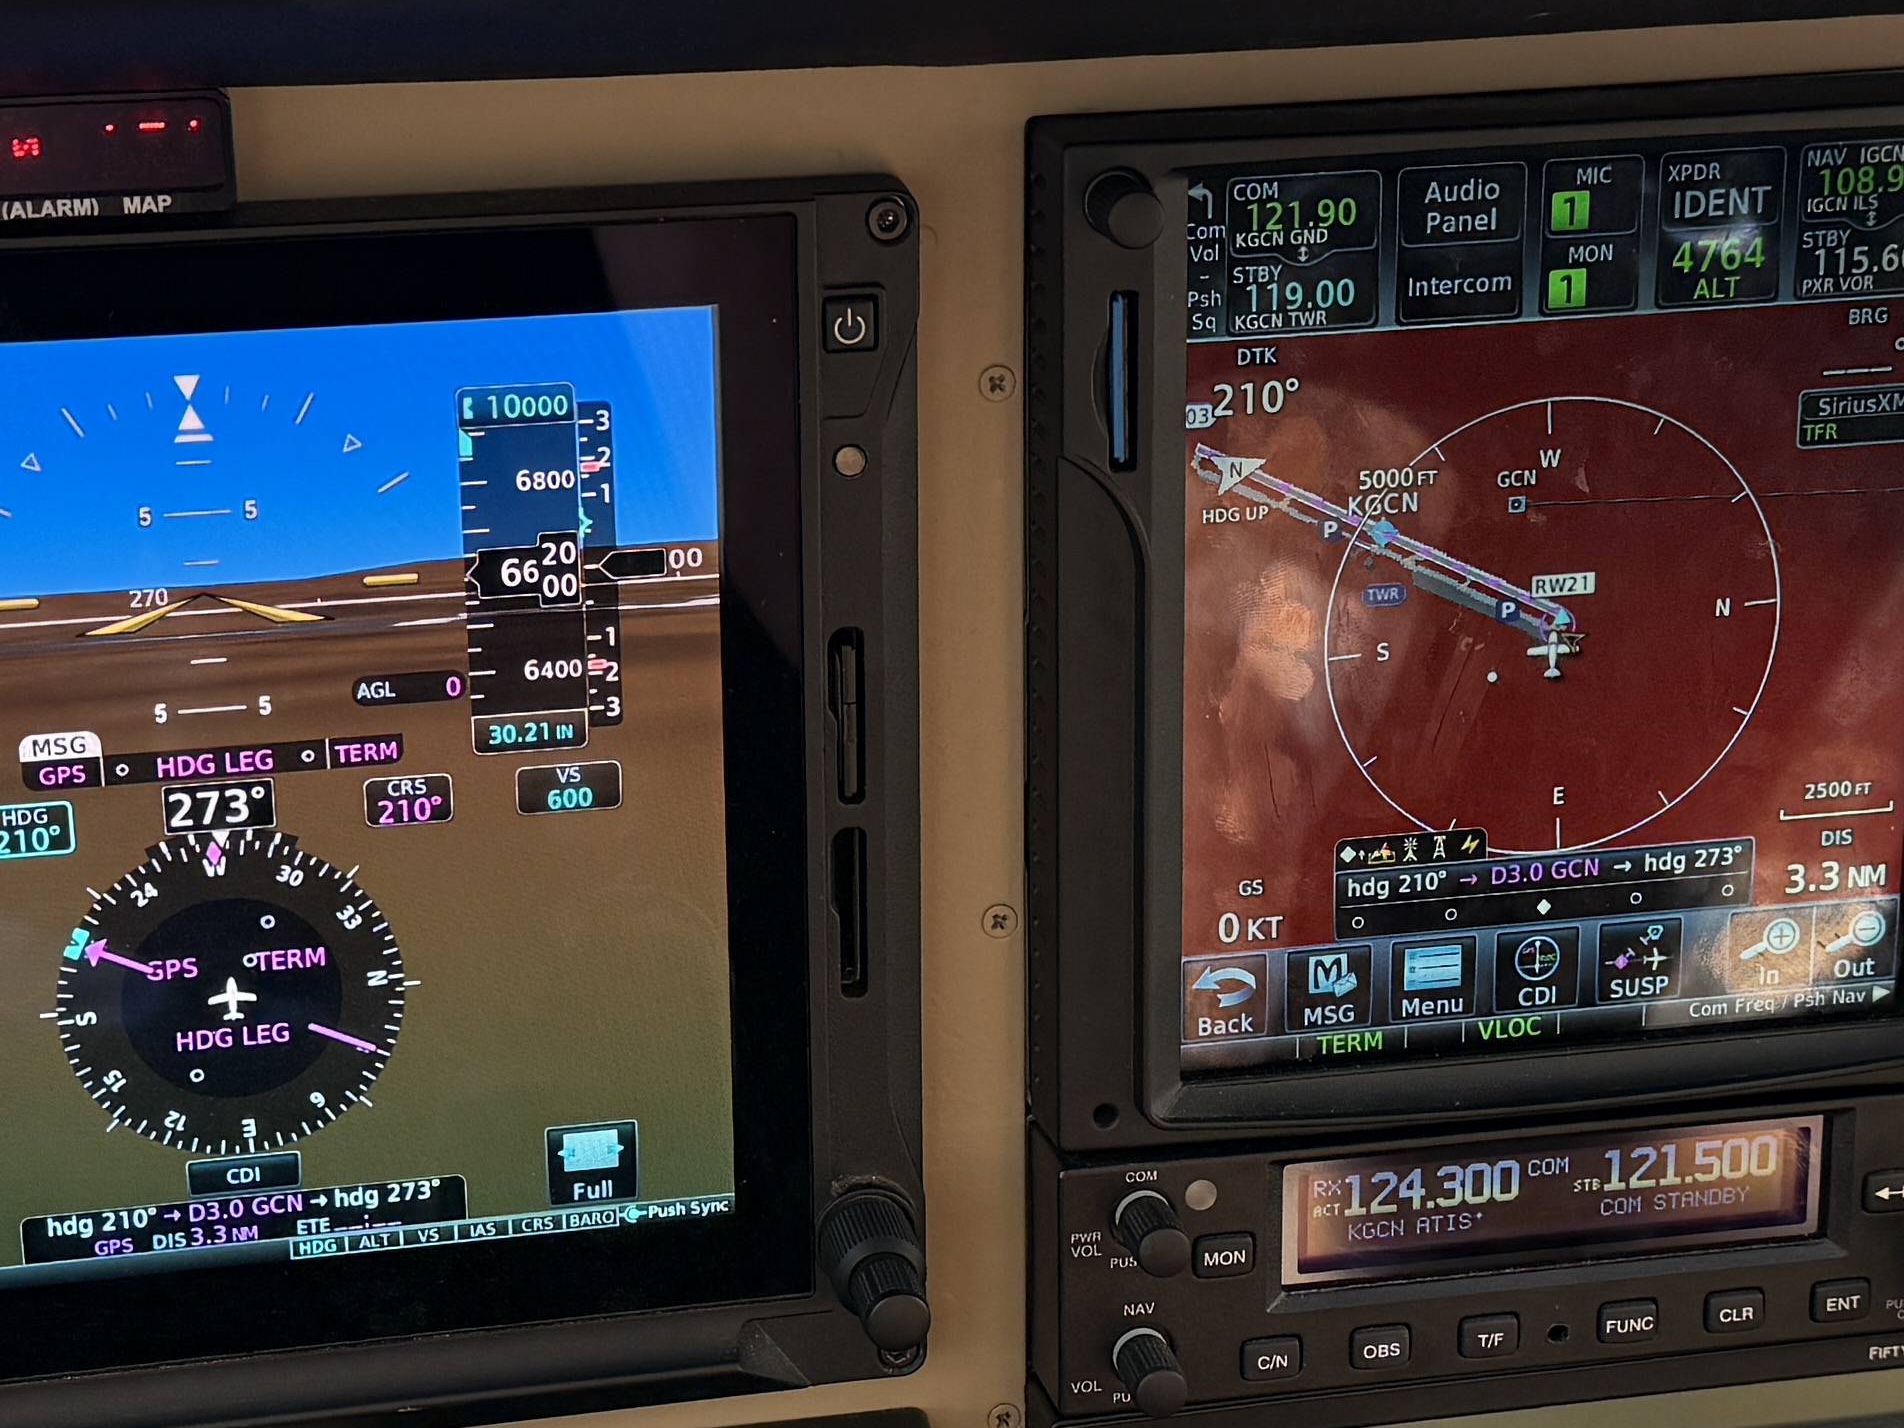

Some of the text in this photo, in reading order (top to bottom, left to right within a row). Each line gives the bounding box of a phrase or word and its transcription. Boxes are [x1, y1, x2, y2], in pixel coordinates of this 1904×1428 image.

[1668, 162, 1721, 183] XPDR
[1234, 182, 1279, 202] COM
[1424, 179, 1499, 205] Audio
[1673, 187, 1772, 220] IDENT
[2, 198, 100, 222] (ALARM)
[123, 195, 172, 215] MAP
[1246, 199, 1356, 230] 121.90
[1426, 208, 1497, 236] Panel
[1672, 240, 1765, 273] 4764
[1233, 265, 1281, 285] STBY
[1408, 271, 1512, 298] Intercom
[1246, 279, 1355, 310] 119.00
[488, 392, 568, 420] 10000
[516, 468, 575, 492] 6800
[32, 733, 86, 758] MSG
[335, 740, 397, 764] TERM
[156, 747, 274, 778] HDG LEG
[169, 787, 265, 826] 273°
[1610, 974, 1669, 998] SUSP
[1477, 1015, 1542, 1041] VLOC
[1604, 1135, 1777, 1192] 121.500
[572, 1178, 612, 1201] Full
[1345, 1159, 1519, 1216] 124.300
[1600, 1185, 1750, 1215] COM STANDBY
[649, 1200, 729, 1225] Push Sync
[1203, 1248, 1246, 1268] MON
[1825, 1294, 1861, 1314] ENT
[1606, 1314, 1654, 1335] FUNC
[1363, 1340, 1401, 1361] OBS
